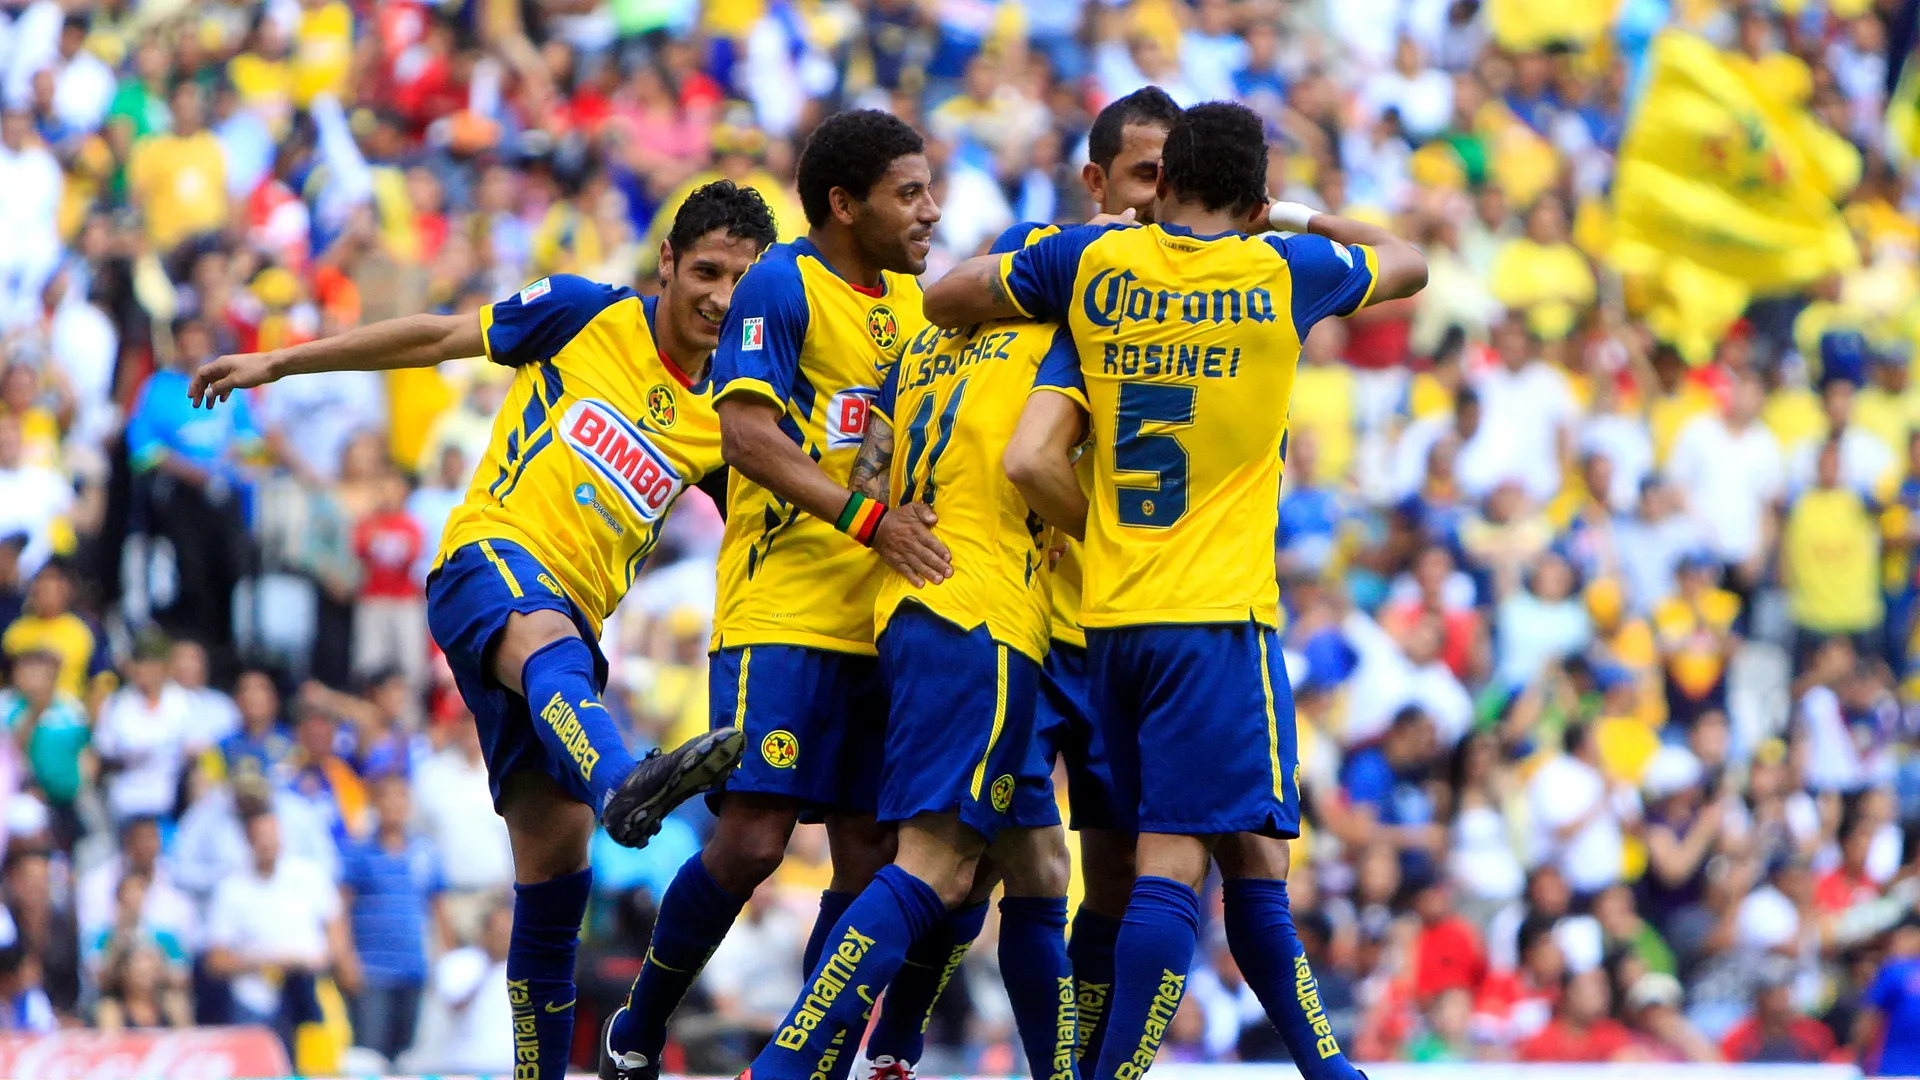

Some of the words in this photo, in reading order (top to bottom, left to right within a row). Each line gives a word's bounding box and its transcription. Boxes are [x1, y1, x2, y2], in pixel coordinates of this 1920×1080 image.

[1084, 268, 1277, 335] Corona
[1103, 343, 1241, 378] ROSINEI
[569, 406, 673, 510] BIMBO
[899, 376, 970, 507] 11
[1113, 380, 1198, 530] 5
[540, 691, 600, 781] Banamex
[507, 979, 540, 1080] Banamex
[775, 926, 876, 1051] Banamex
[1049, 975, 1077, 1080] Banamex
[1114, 968, 1187, 1080] Banamex
[1294, 952, 1341, 1059] Banamex
